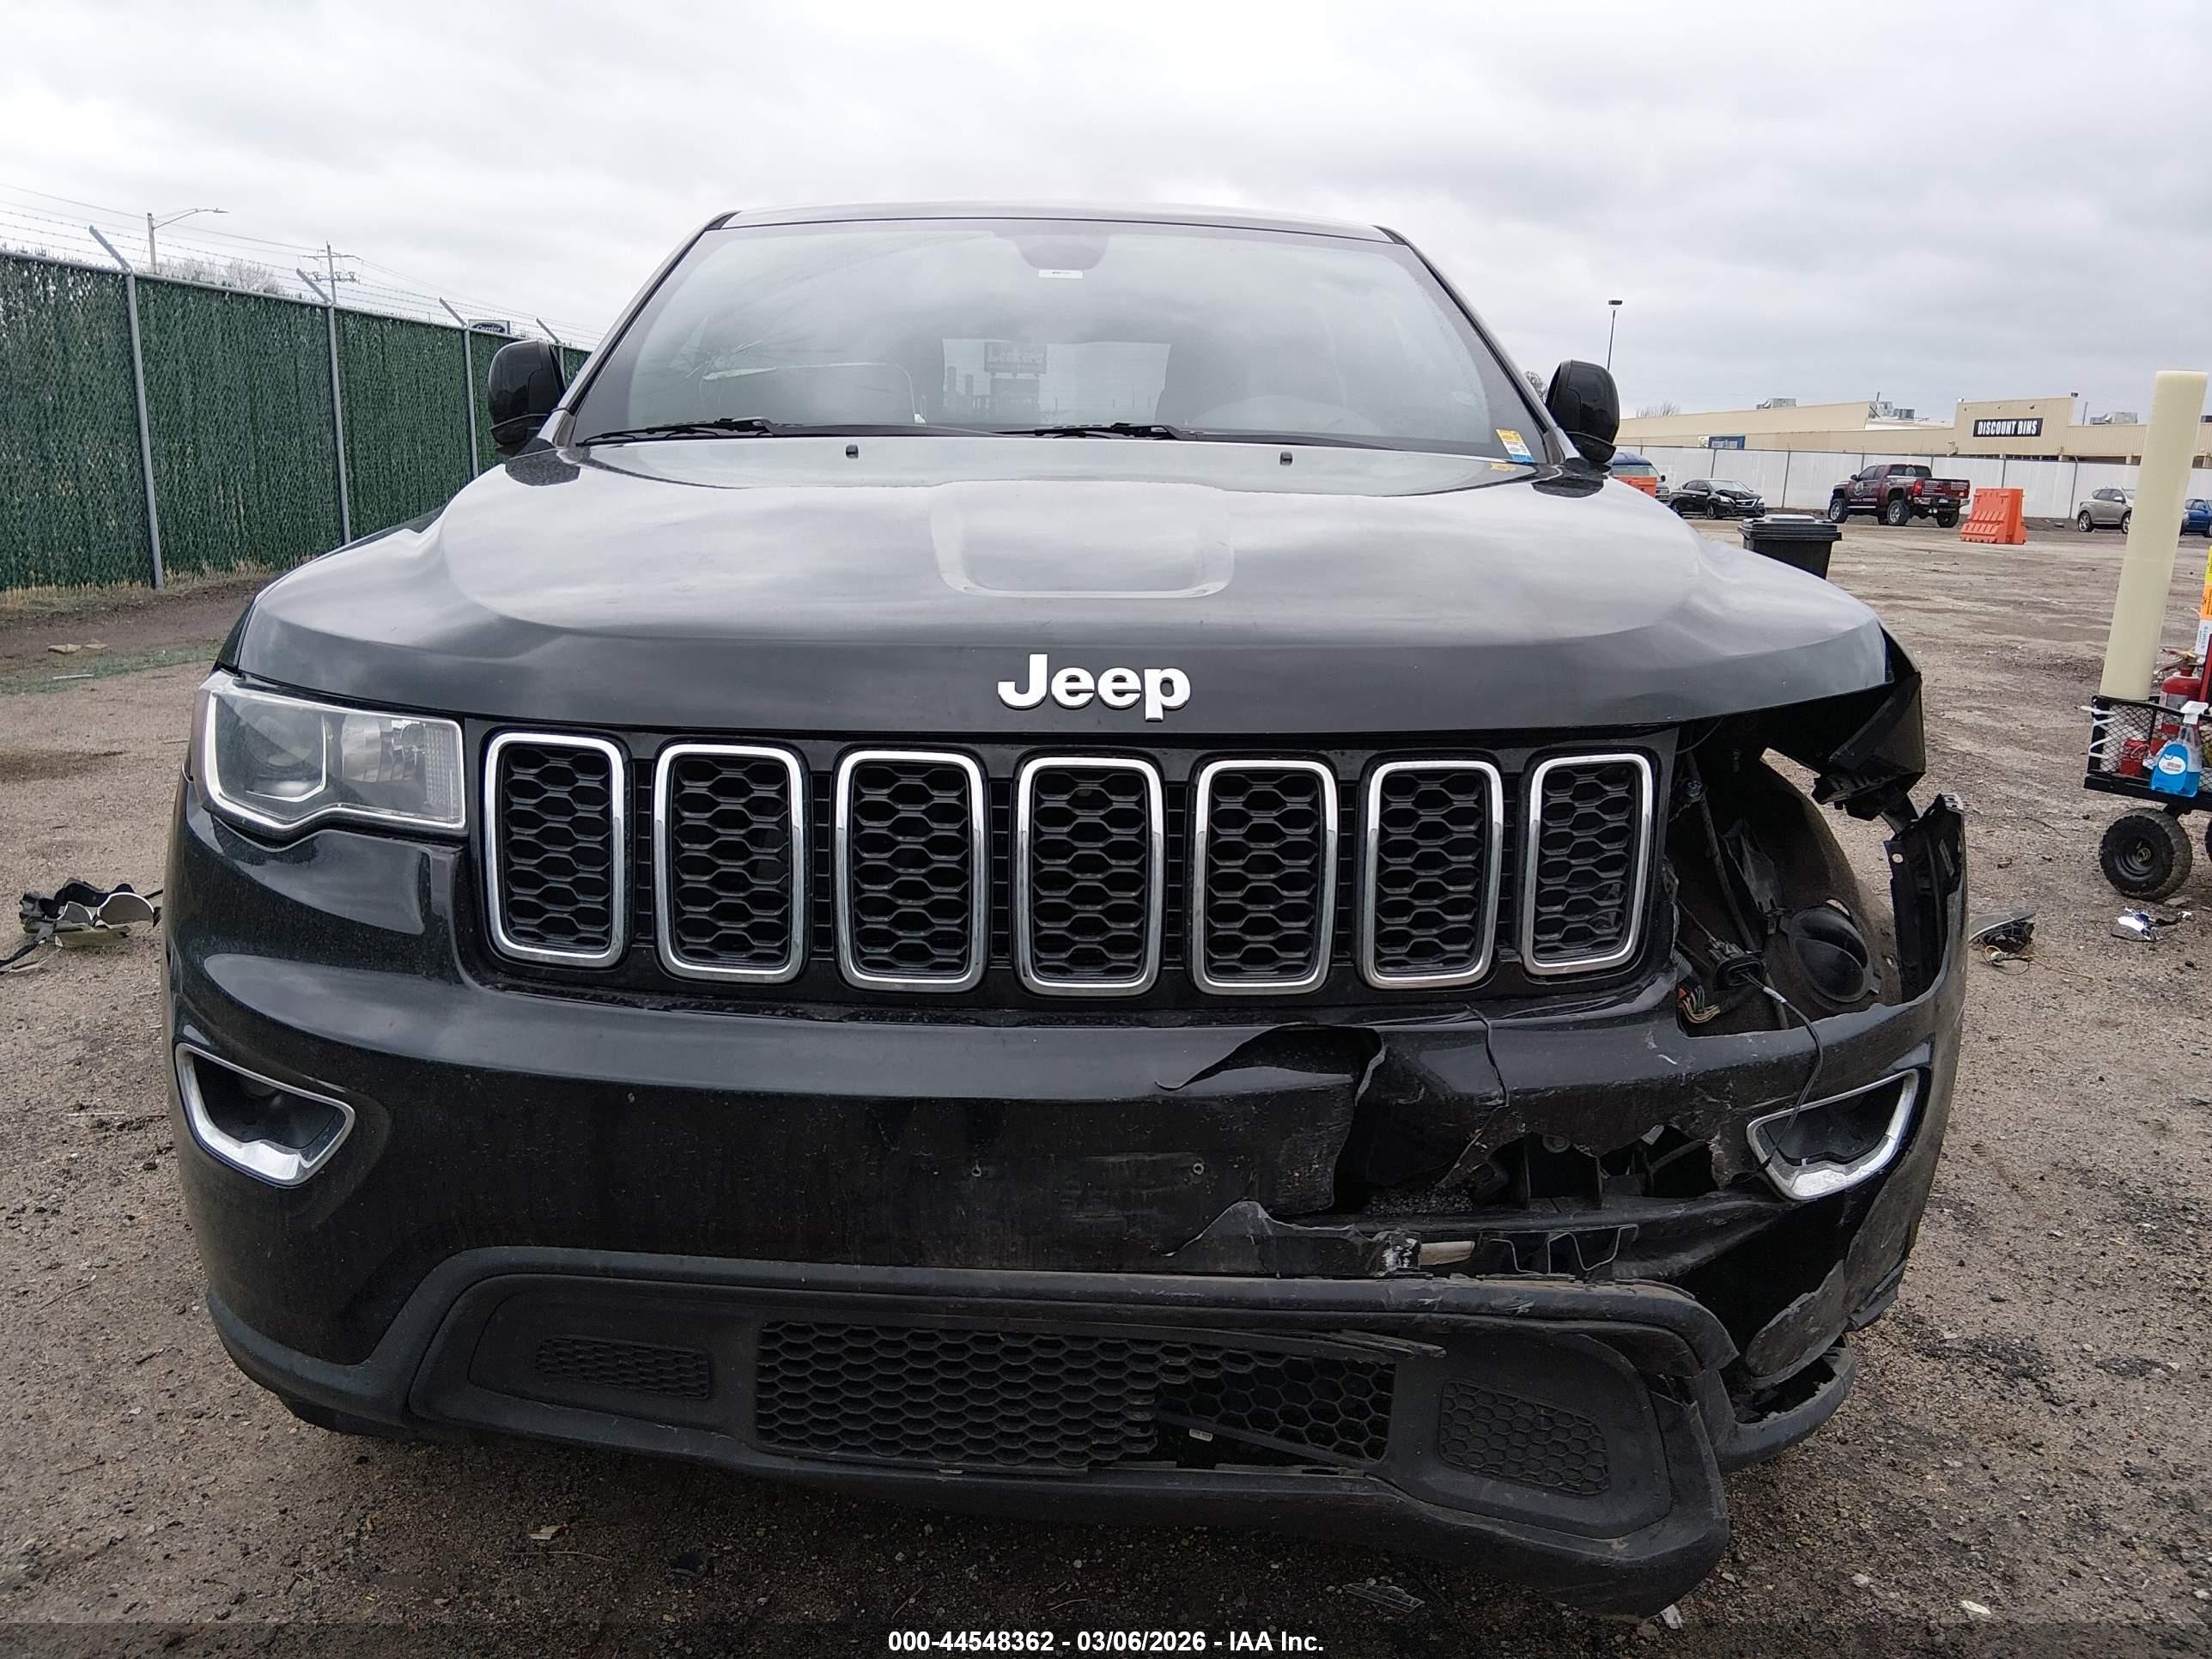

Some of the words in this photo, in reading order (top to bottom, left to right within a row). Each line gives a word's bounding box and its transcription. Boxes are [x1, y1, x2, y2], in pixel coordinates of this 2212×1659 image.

[1978, 421, 2016, 434] DISCOUNT
[2017, 420, 2038, 434] BINS
[997, 653, 1192, 723] Jeep
